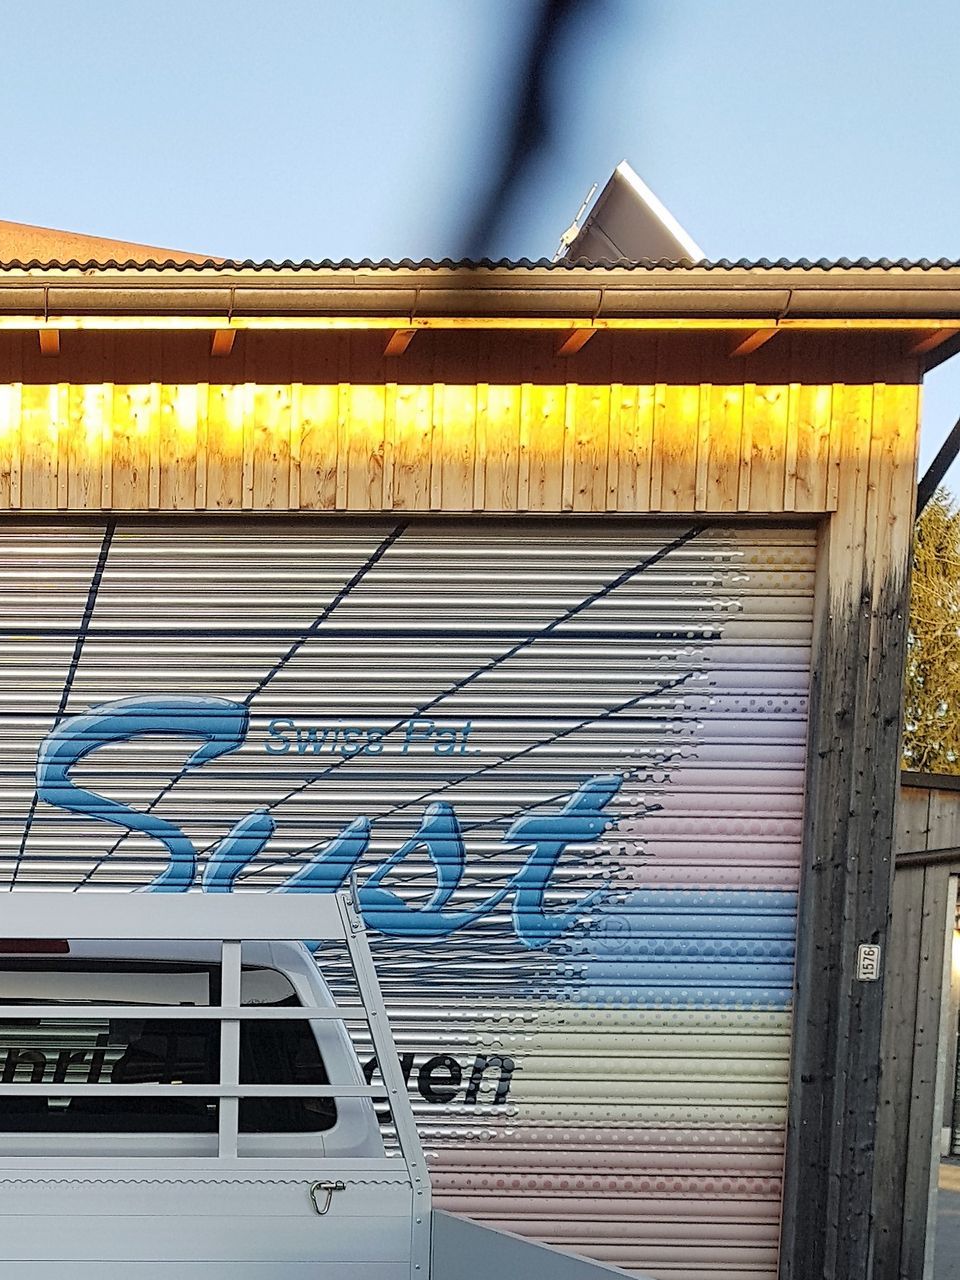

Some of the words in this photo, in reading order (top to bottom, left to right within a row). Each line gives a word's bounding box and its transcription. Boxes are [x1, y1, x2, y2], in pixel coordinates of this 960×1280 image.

[264, 718, 385, 756] Swiss
[401, 718, 482, 756] Pat.
[863, 949, 875, 975] 1576
